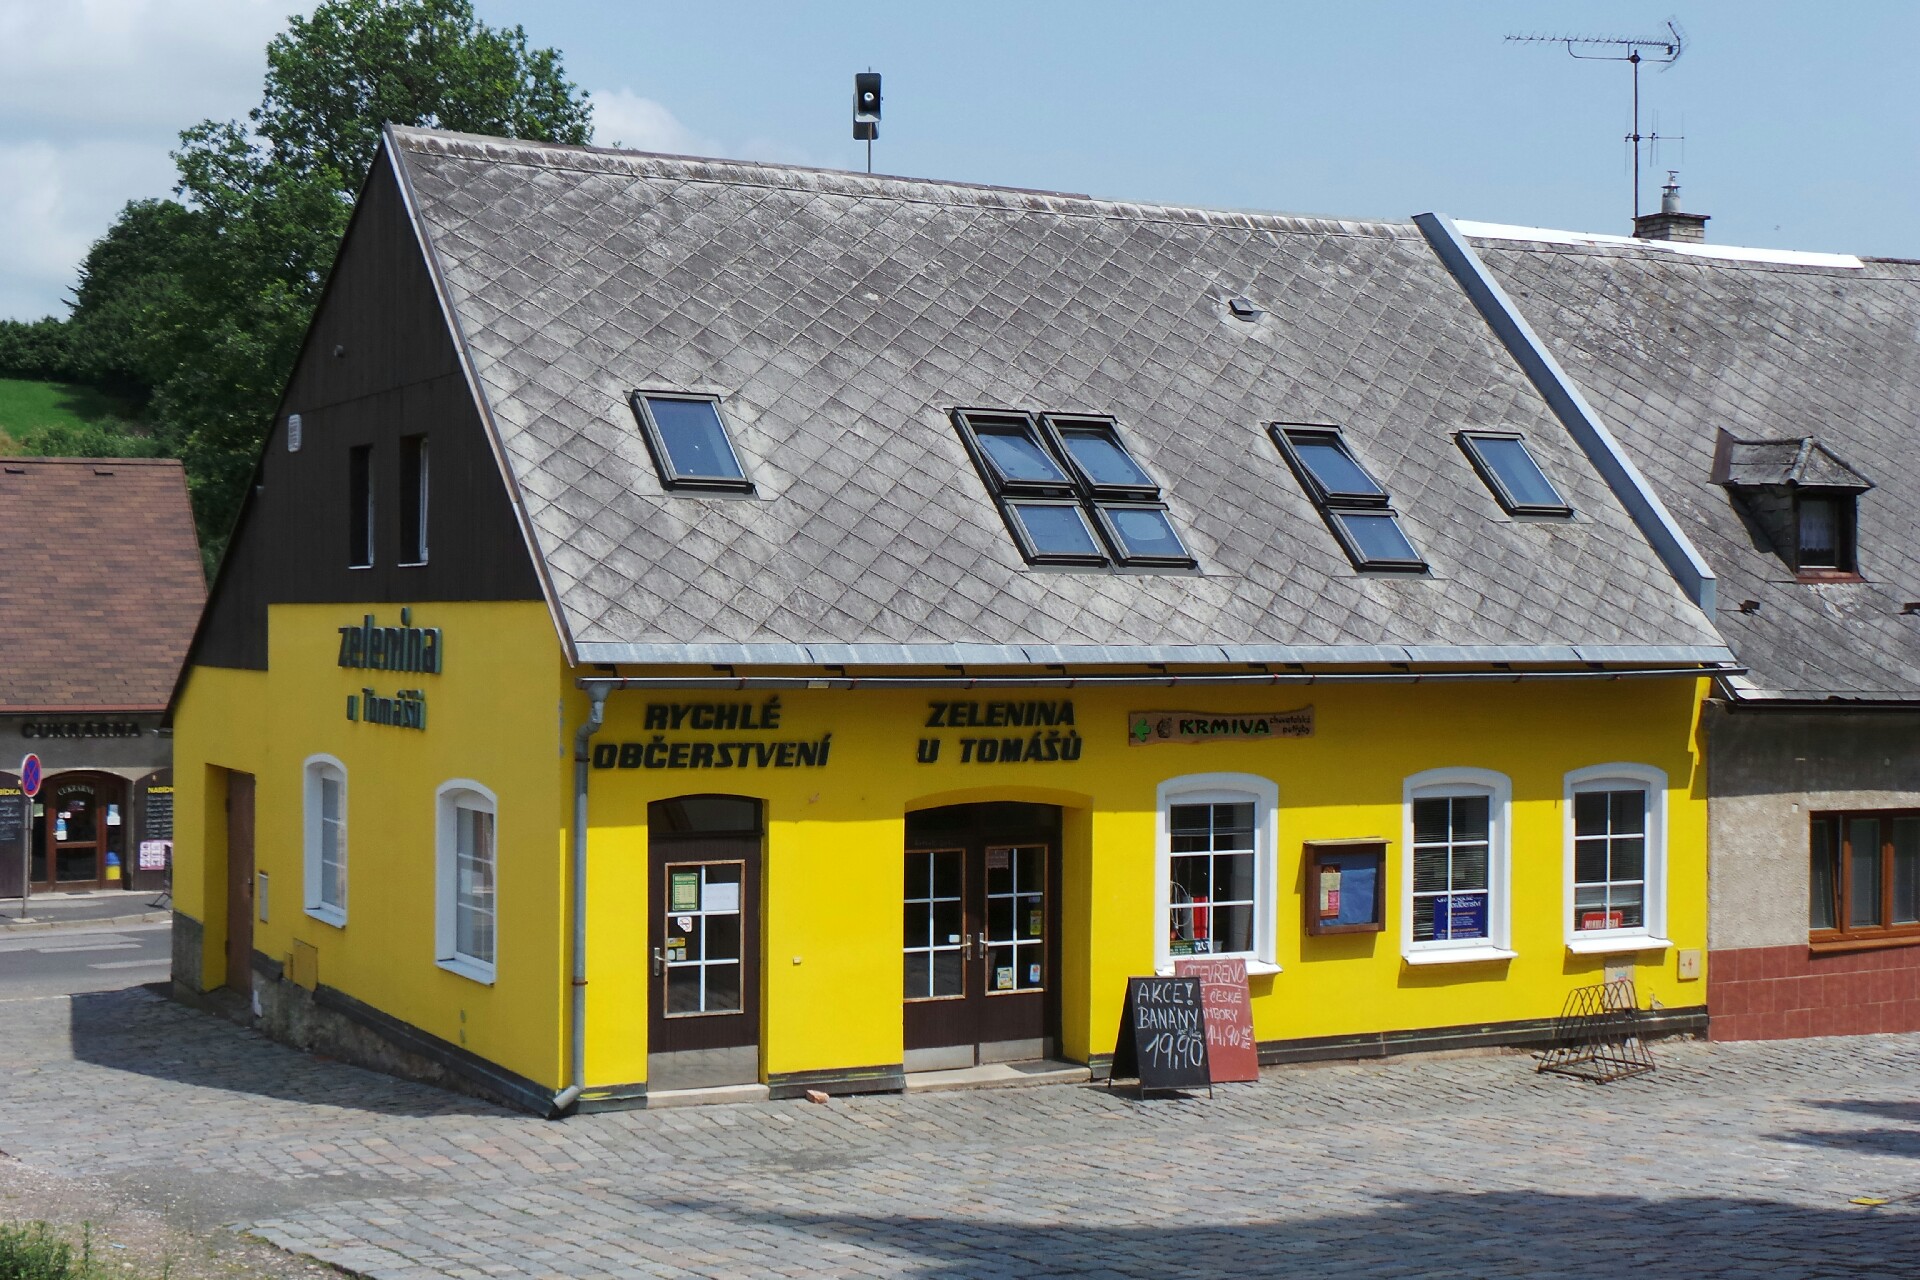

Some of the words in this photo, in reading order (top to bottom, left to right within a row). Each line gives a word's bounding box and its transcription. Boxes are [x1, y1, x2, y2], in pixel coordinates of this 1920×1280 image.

[338, 607, 442, 674] zelenina
[644, 696, 781, 730] RYCHLÉ
[925, 700, 1076, 727] ZELENINA
[21, 721, 142, 739] CUKRÁRNA
[1179, 719, 1270, 735] KRMIVA
[593, 733, 832, 769] OBČERSTVENÍ
[918, 739, 940, 763] U
[960, 729, 1083, 763] TOMÁŠŮ
[1449, 900, 1482, 909] oradenství
[1585, 917, 1619, 930] MIKULÁSKÁ
[1210, 988, 1243, 1004] ČESKÉ
[1138, 1006, 1198, 1029] BANÁNY
[1207, 1025, 1241, 1047] 14,90
[1145, 1032, 1204, 1069] 19,90
